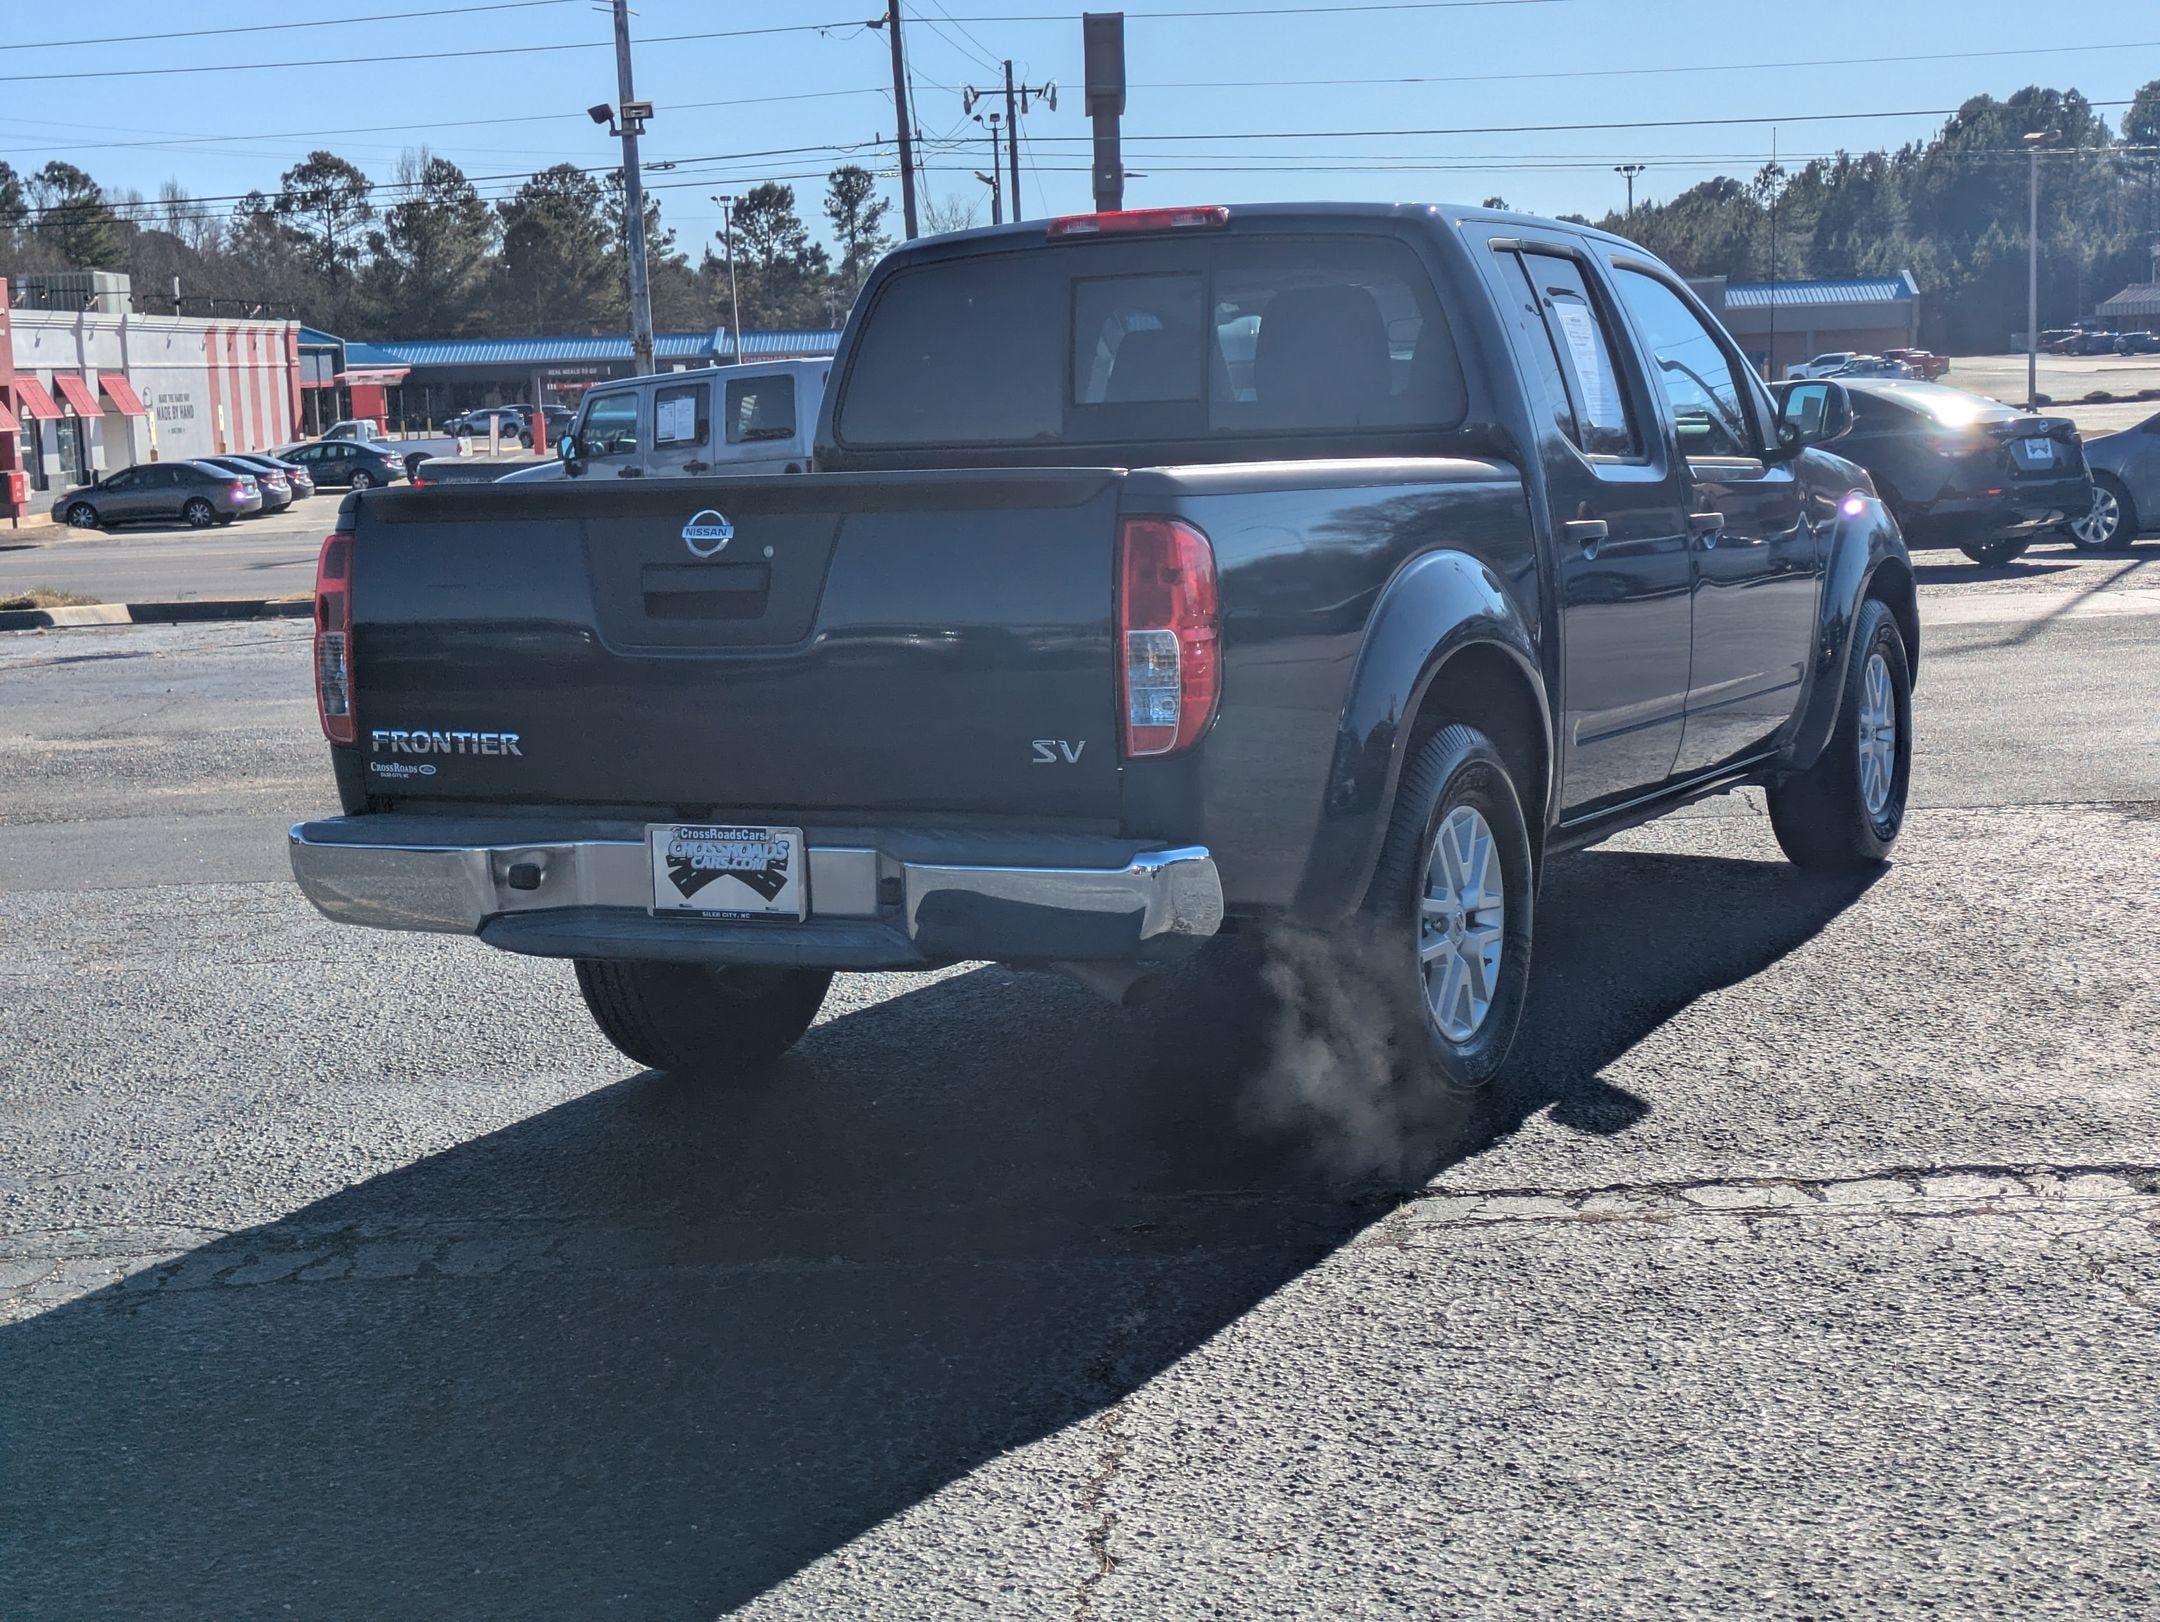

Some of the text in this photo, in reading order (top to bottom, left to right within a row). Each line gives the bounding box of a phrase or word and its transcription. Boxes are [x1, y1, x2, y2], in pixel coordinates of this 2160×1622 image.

[157, 404, 194, 420] MADE BY HAND
[685, 527, 727, 537] NISSAN
[372, 730, 523, 756] FRONTIER
[1032, 739, 1086, 763] SV
